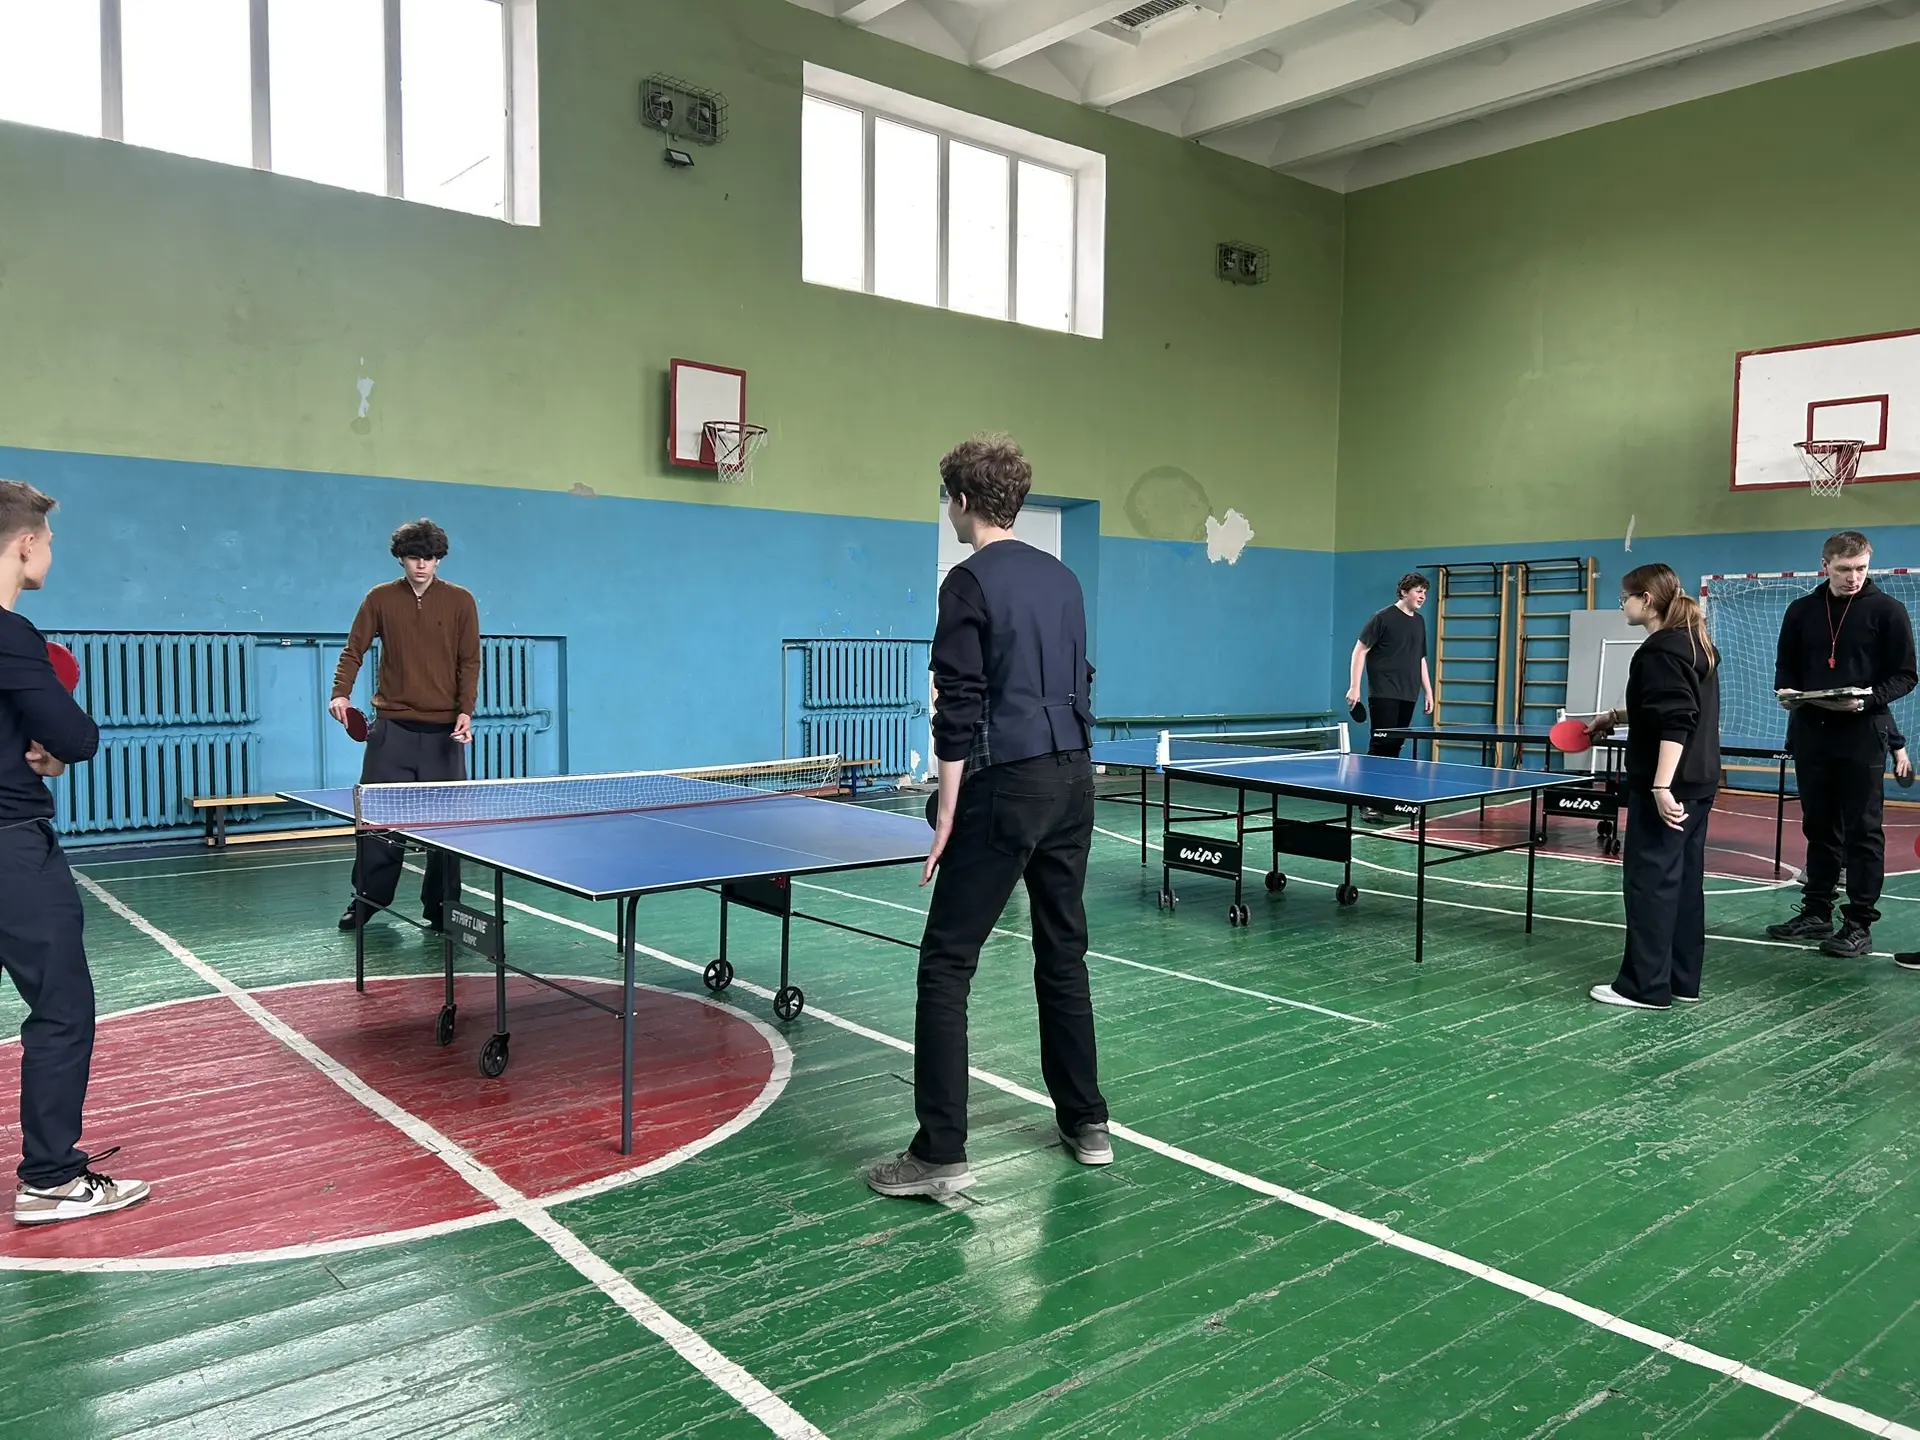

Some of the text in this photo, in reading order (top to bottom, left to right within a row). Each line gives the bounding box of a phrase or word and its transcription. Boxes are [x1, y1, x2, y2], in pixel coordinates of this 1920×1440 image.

[1394, 804, 1419, 814] wips
[1559, 797, 1601, 810] wips
[1180, 847, 1223, 864] wips
[451, 909, 473, 928] START
